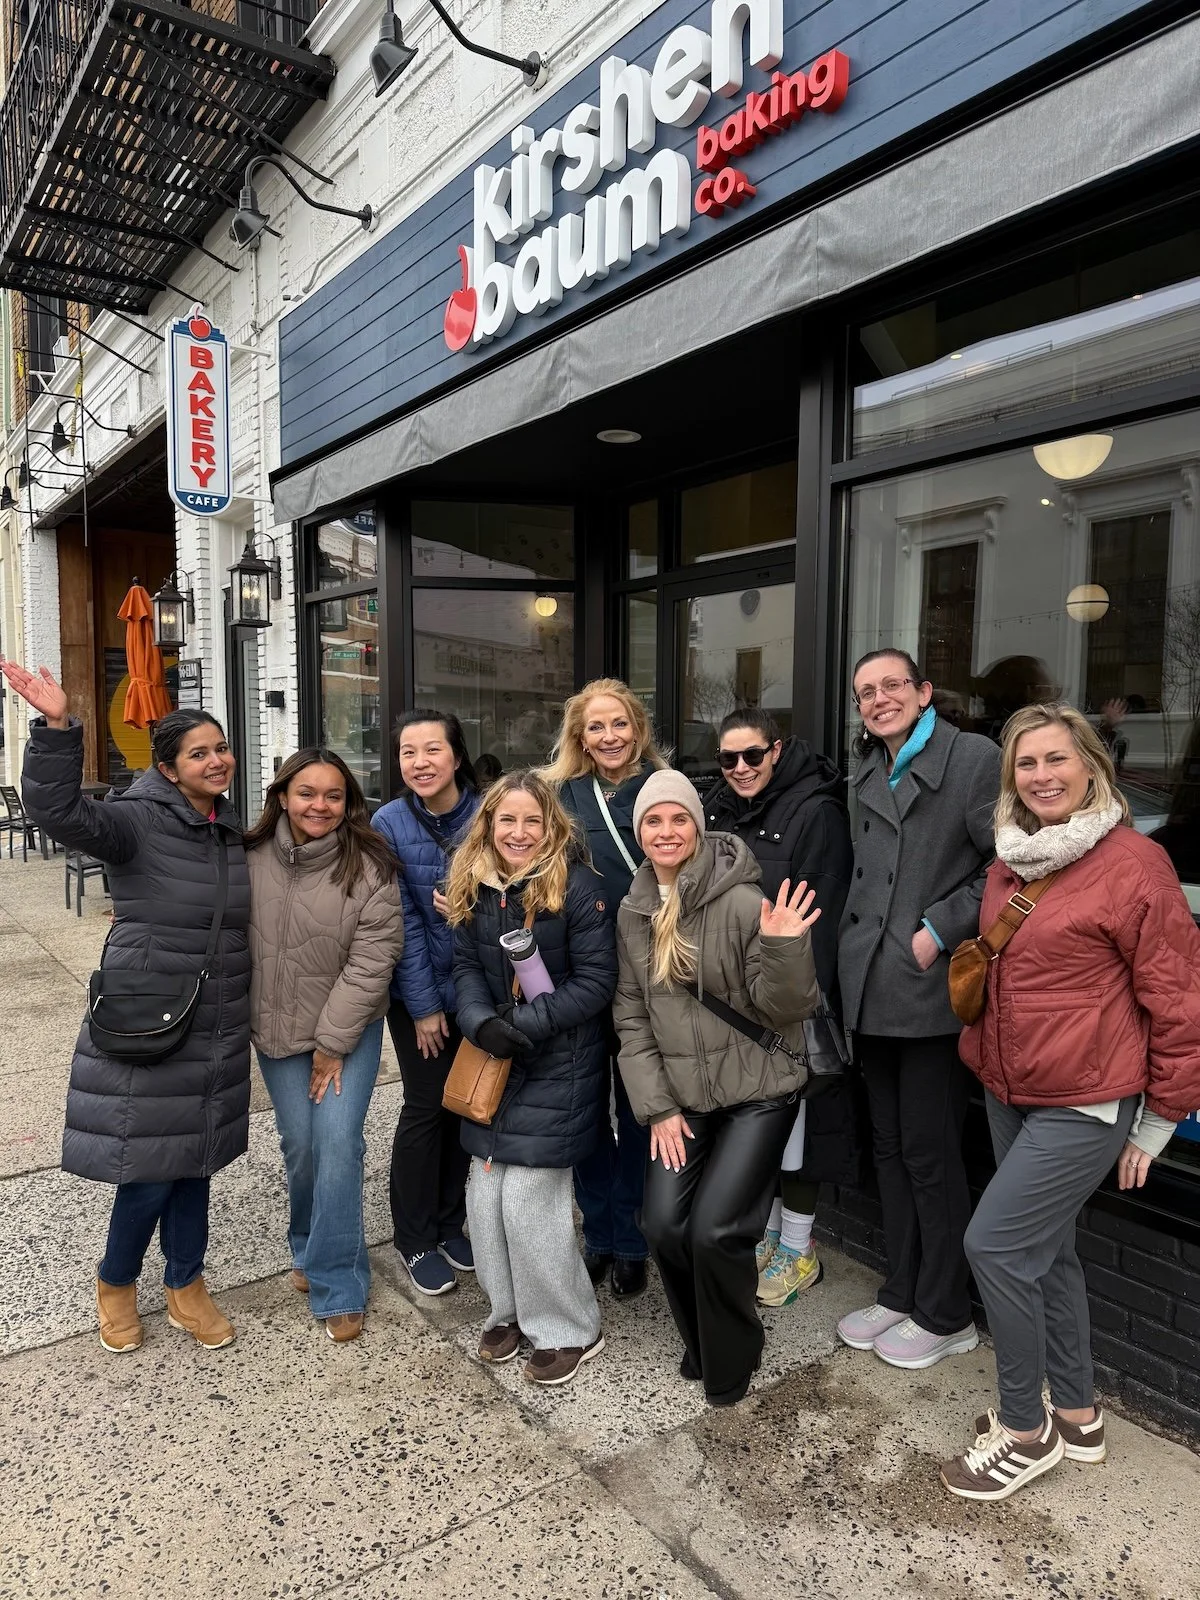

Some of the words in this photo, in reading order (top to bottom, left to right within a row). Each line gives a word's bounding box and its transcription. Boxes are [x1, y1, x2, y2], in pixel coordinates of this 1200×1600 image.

[474, 0, 783, 244] kirshen
[696, 48, 849, 172] baking
[473, 148, 692, 343] baum
[695, 167, 757, 218] co.
[188, 345, 216, 488] BAKERY
[187, 494, 219, 508] CAFE
